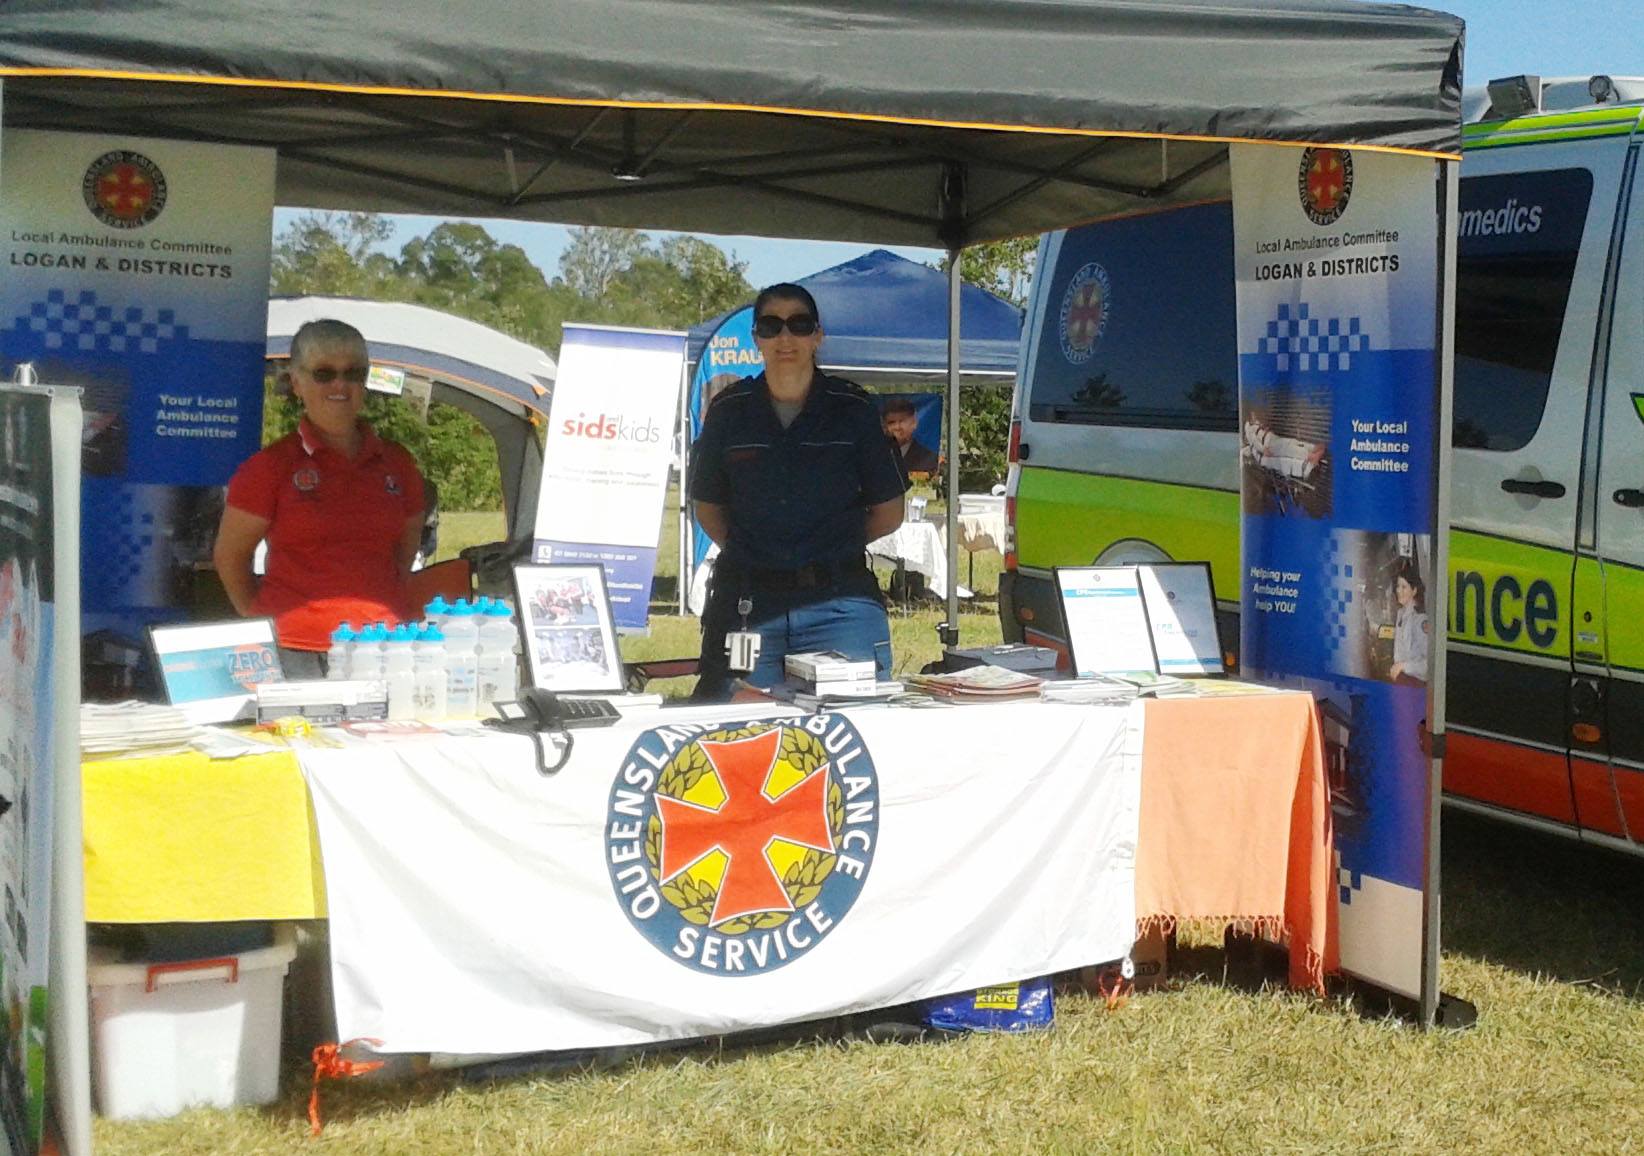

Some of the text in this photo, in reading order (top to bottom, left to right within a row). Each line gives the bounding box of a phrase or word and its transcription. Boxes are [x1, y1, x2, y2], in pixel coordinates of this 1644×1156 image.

[1458, 198, 1543, 237] medics
[12, 230, 233, 256] Local Ambulance Committee
[1256, 229, 1400, 255] Local Ambulance Committee
[10, 251, 233, 280] LOGAN & DISTRICTS
[1255, 253, 1400, 281] LOGAN & DISTRICTS
[709, 334, 740, 349] Jon
[159, 393, 238, 409] Your Local
[156, 408, 240, 424] Ambulance
[1351, 418, 1408, 435] Your Local
[155, 424, 238, 439] Committee
[561, 411, 617, 440] sids
[617, 414, 660, 444] kids
[1350, 438, 1410, 453] Ambulance
[1350, 455, 1410, 473] Committee
[1249, 566, 1301, 583] Helping your
[1252, 582, 1299, 599] Ambulance
[1448, 570, 1559, 649] nce
[224, 648, 274, 675] ZERO
[672, 899, 834, 972] SERVICE
